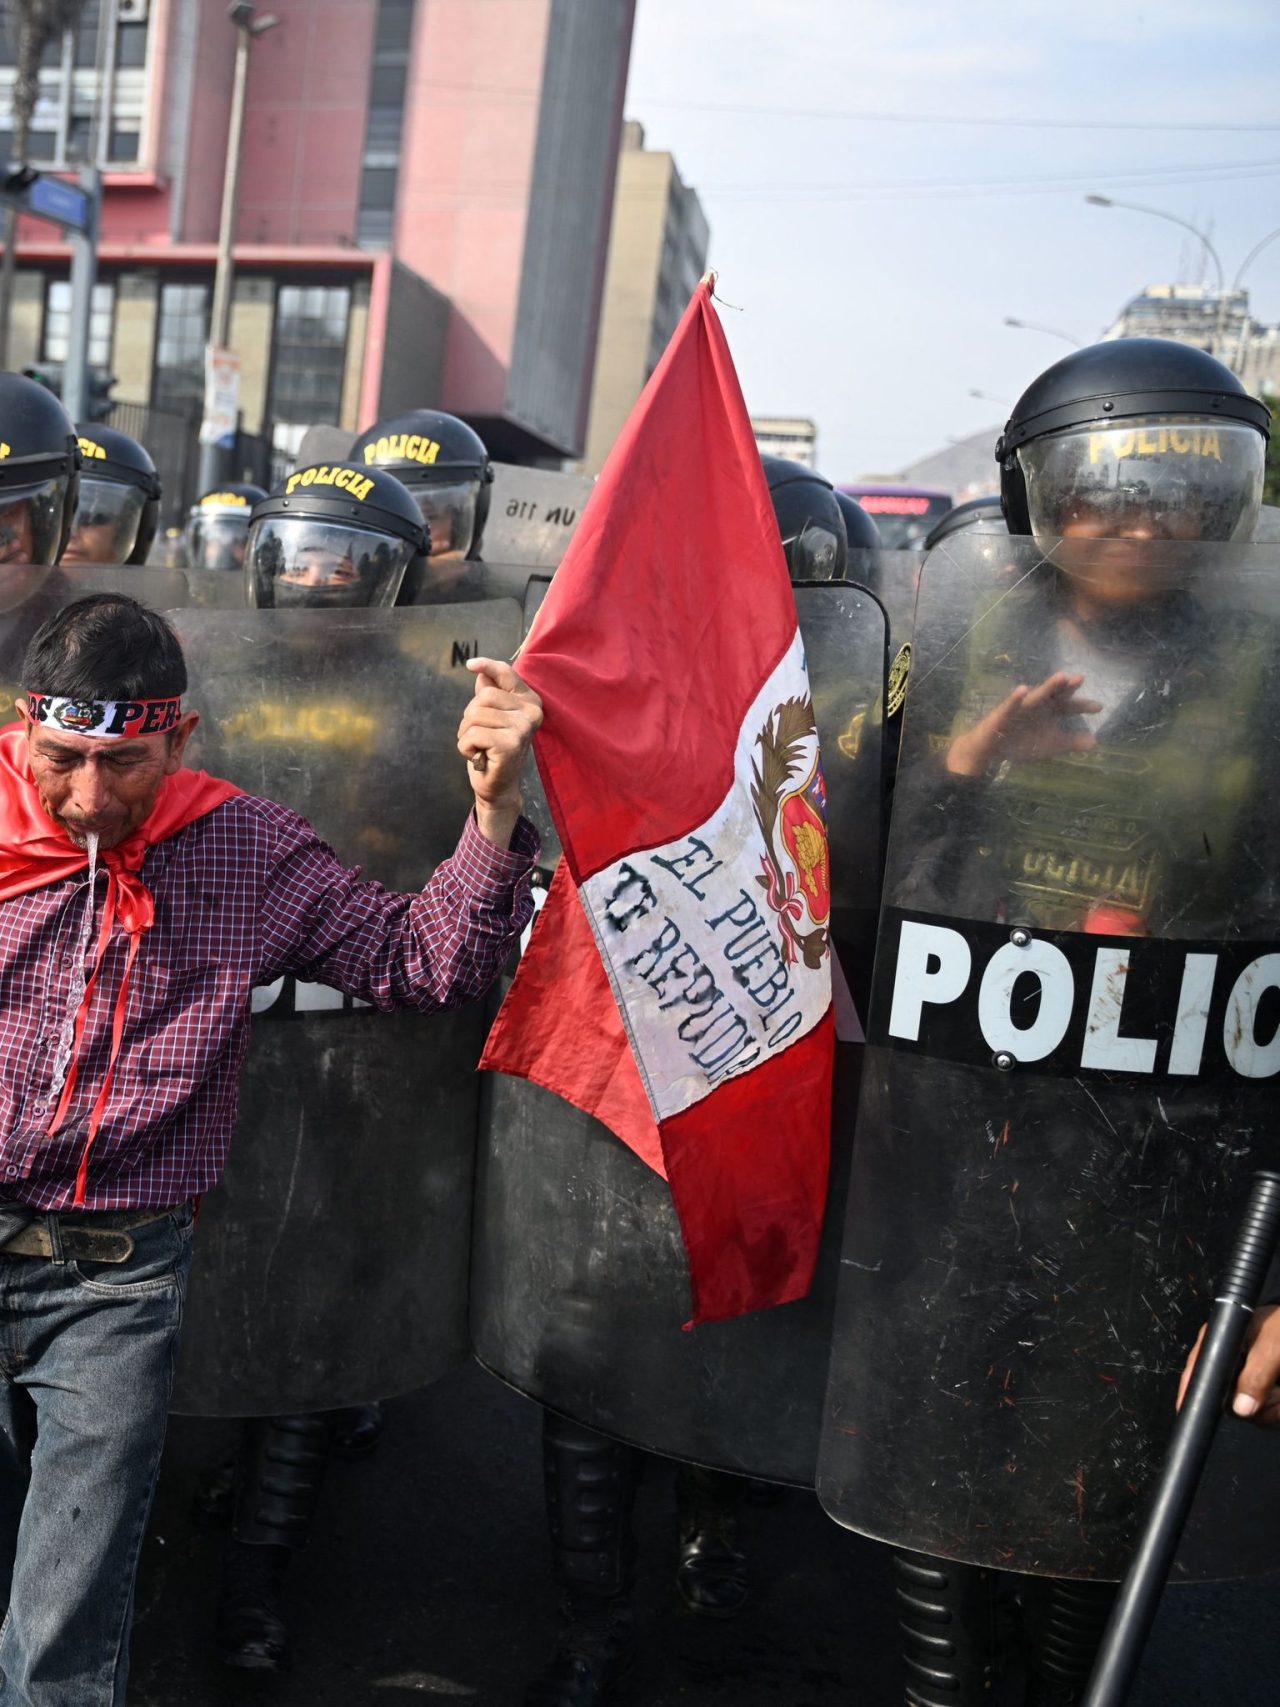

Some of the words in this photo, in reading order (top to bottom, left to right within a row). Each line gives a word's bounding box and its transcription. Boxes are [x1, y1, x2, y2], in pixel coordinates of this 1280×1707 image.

[285, 466, 376, 501] POLICIA
[363, 434, 441, 466] POLICIA
[650, 835, 724, 902] EL
[704, 888, 803, 1049] PUEBLO
[888, 919, 1280, 1080] POLIC
